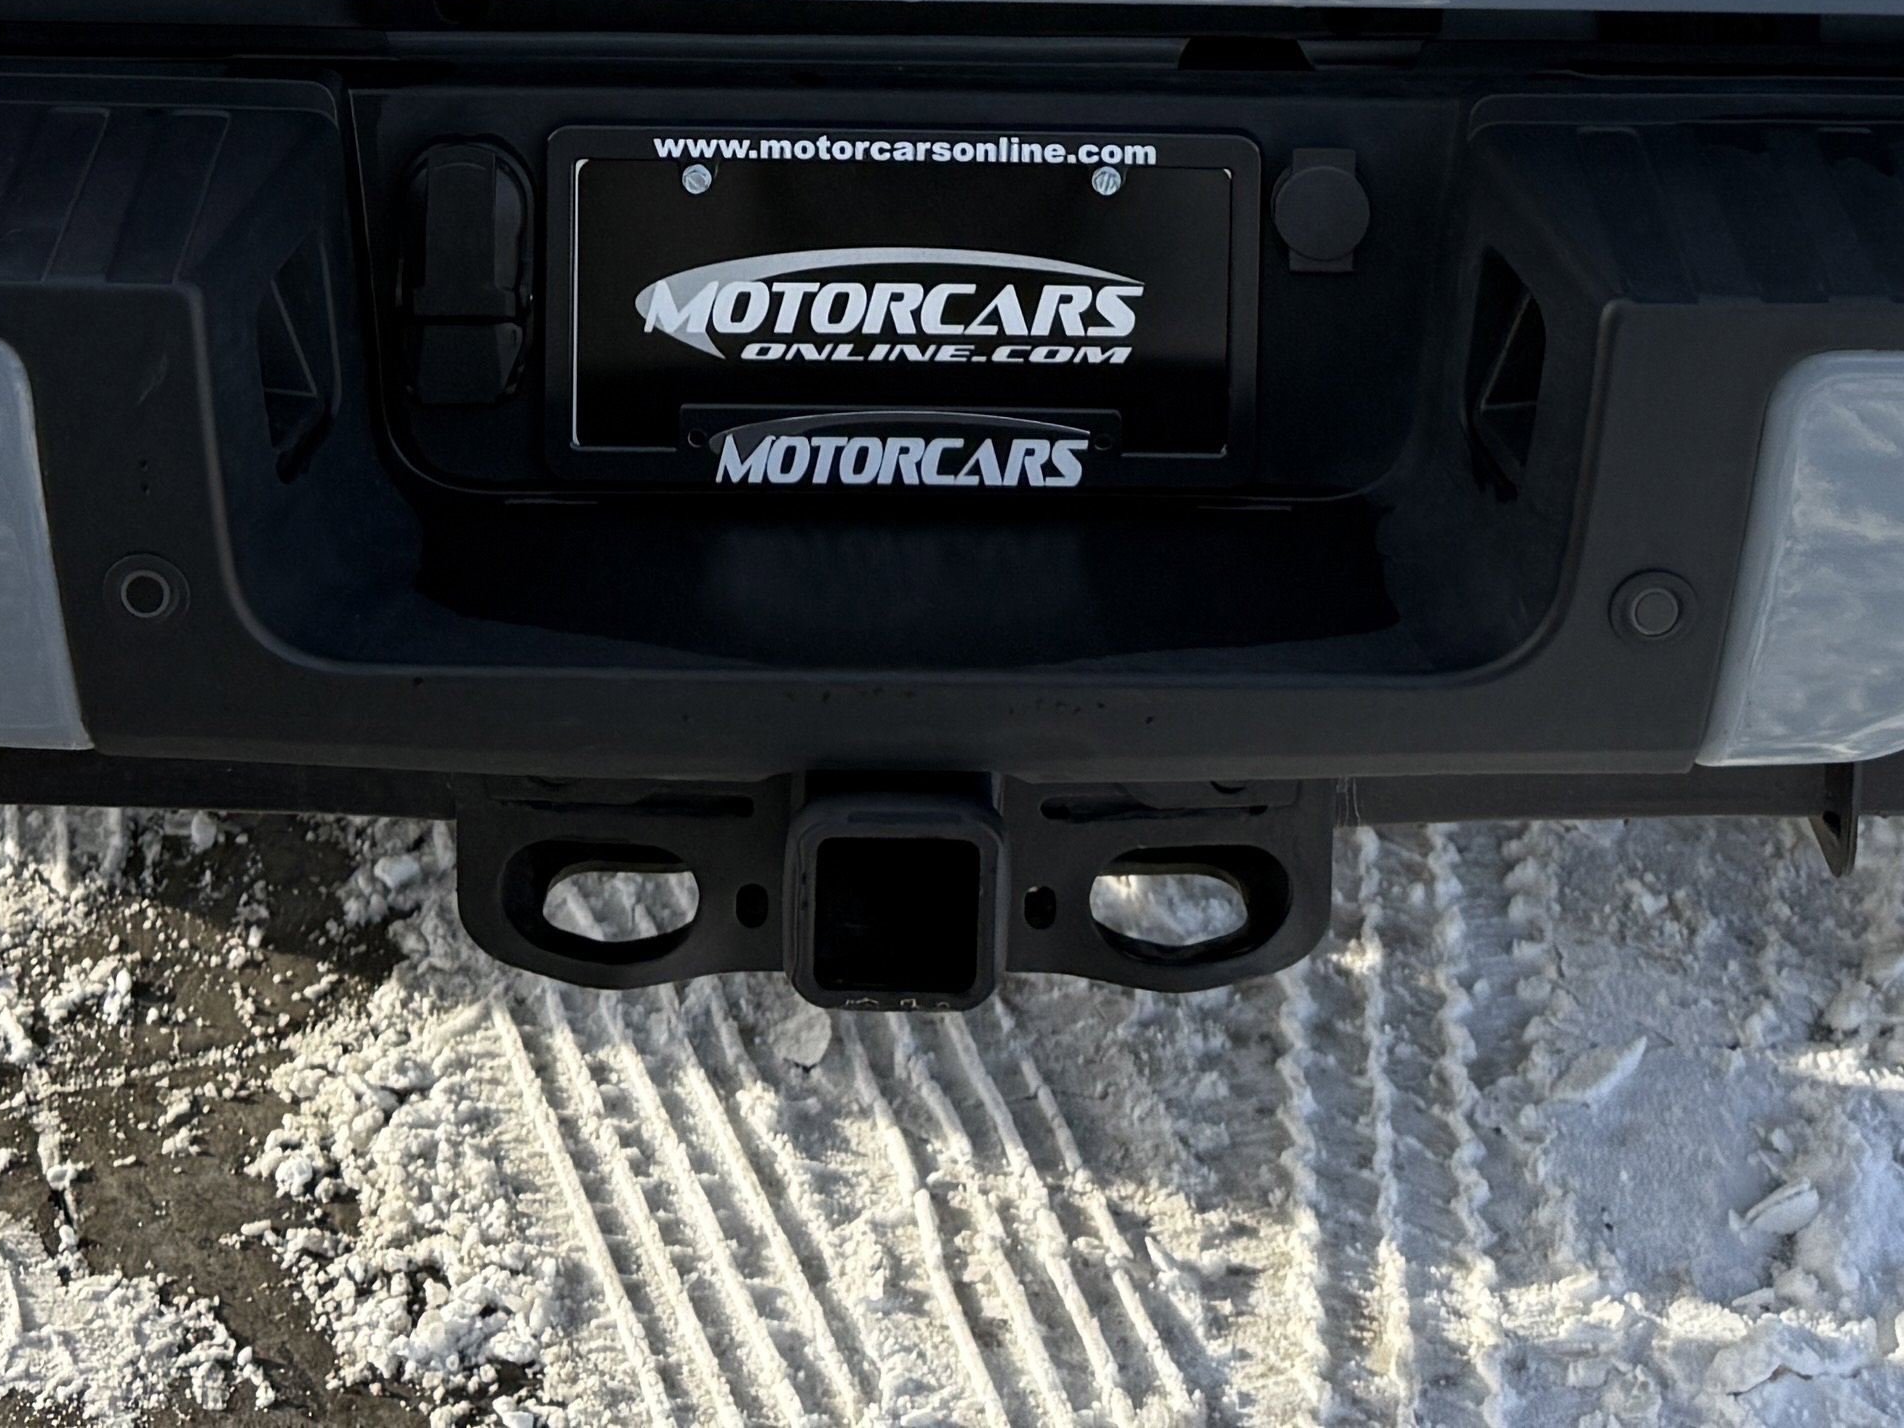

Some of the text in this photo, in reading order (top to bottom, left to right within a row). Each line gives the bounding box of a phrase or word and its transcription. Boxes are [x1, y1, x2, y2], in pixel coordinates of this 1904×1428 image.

[653, 135, 1157, 165] www.motorcarsonline.com
[643, 280, 1144, 337] MOTORCARS
[740, 343, 1133, 364] ONLINE.COM
[715, 433, 1089, 487] MOTORCARS
